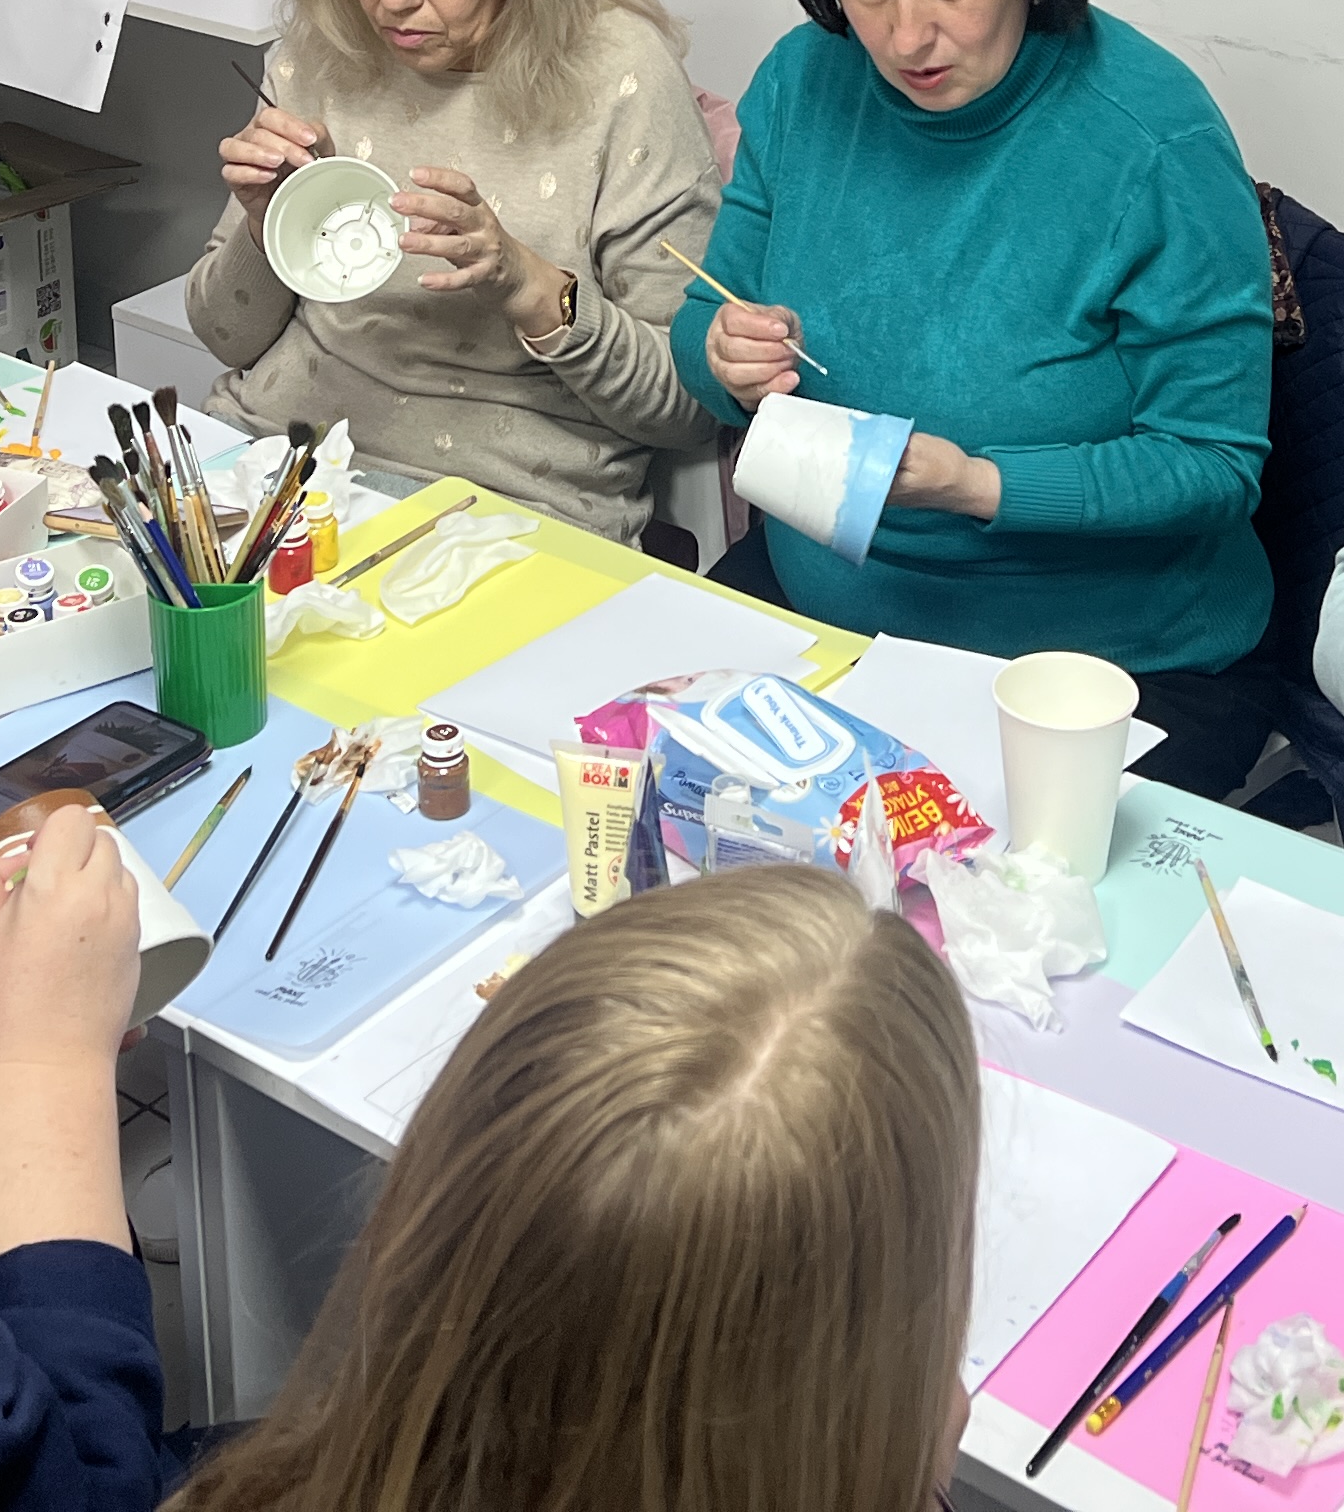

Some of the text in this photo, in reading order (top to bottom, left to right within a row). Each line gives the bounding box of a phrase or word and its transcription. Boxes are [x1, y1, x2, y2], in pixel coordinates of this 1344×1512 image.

[27, 562, 42, 573] 21
[763, 694, 807, 750] Thank You
[583, 762, 613, 776] CREA
[582, 772, 611, 787] BOX
[583, 811, 601, 903] Matt Pastel
